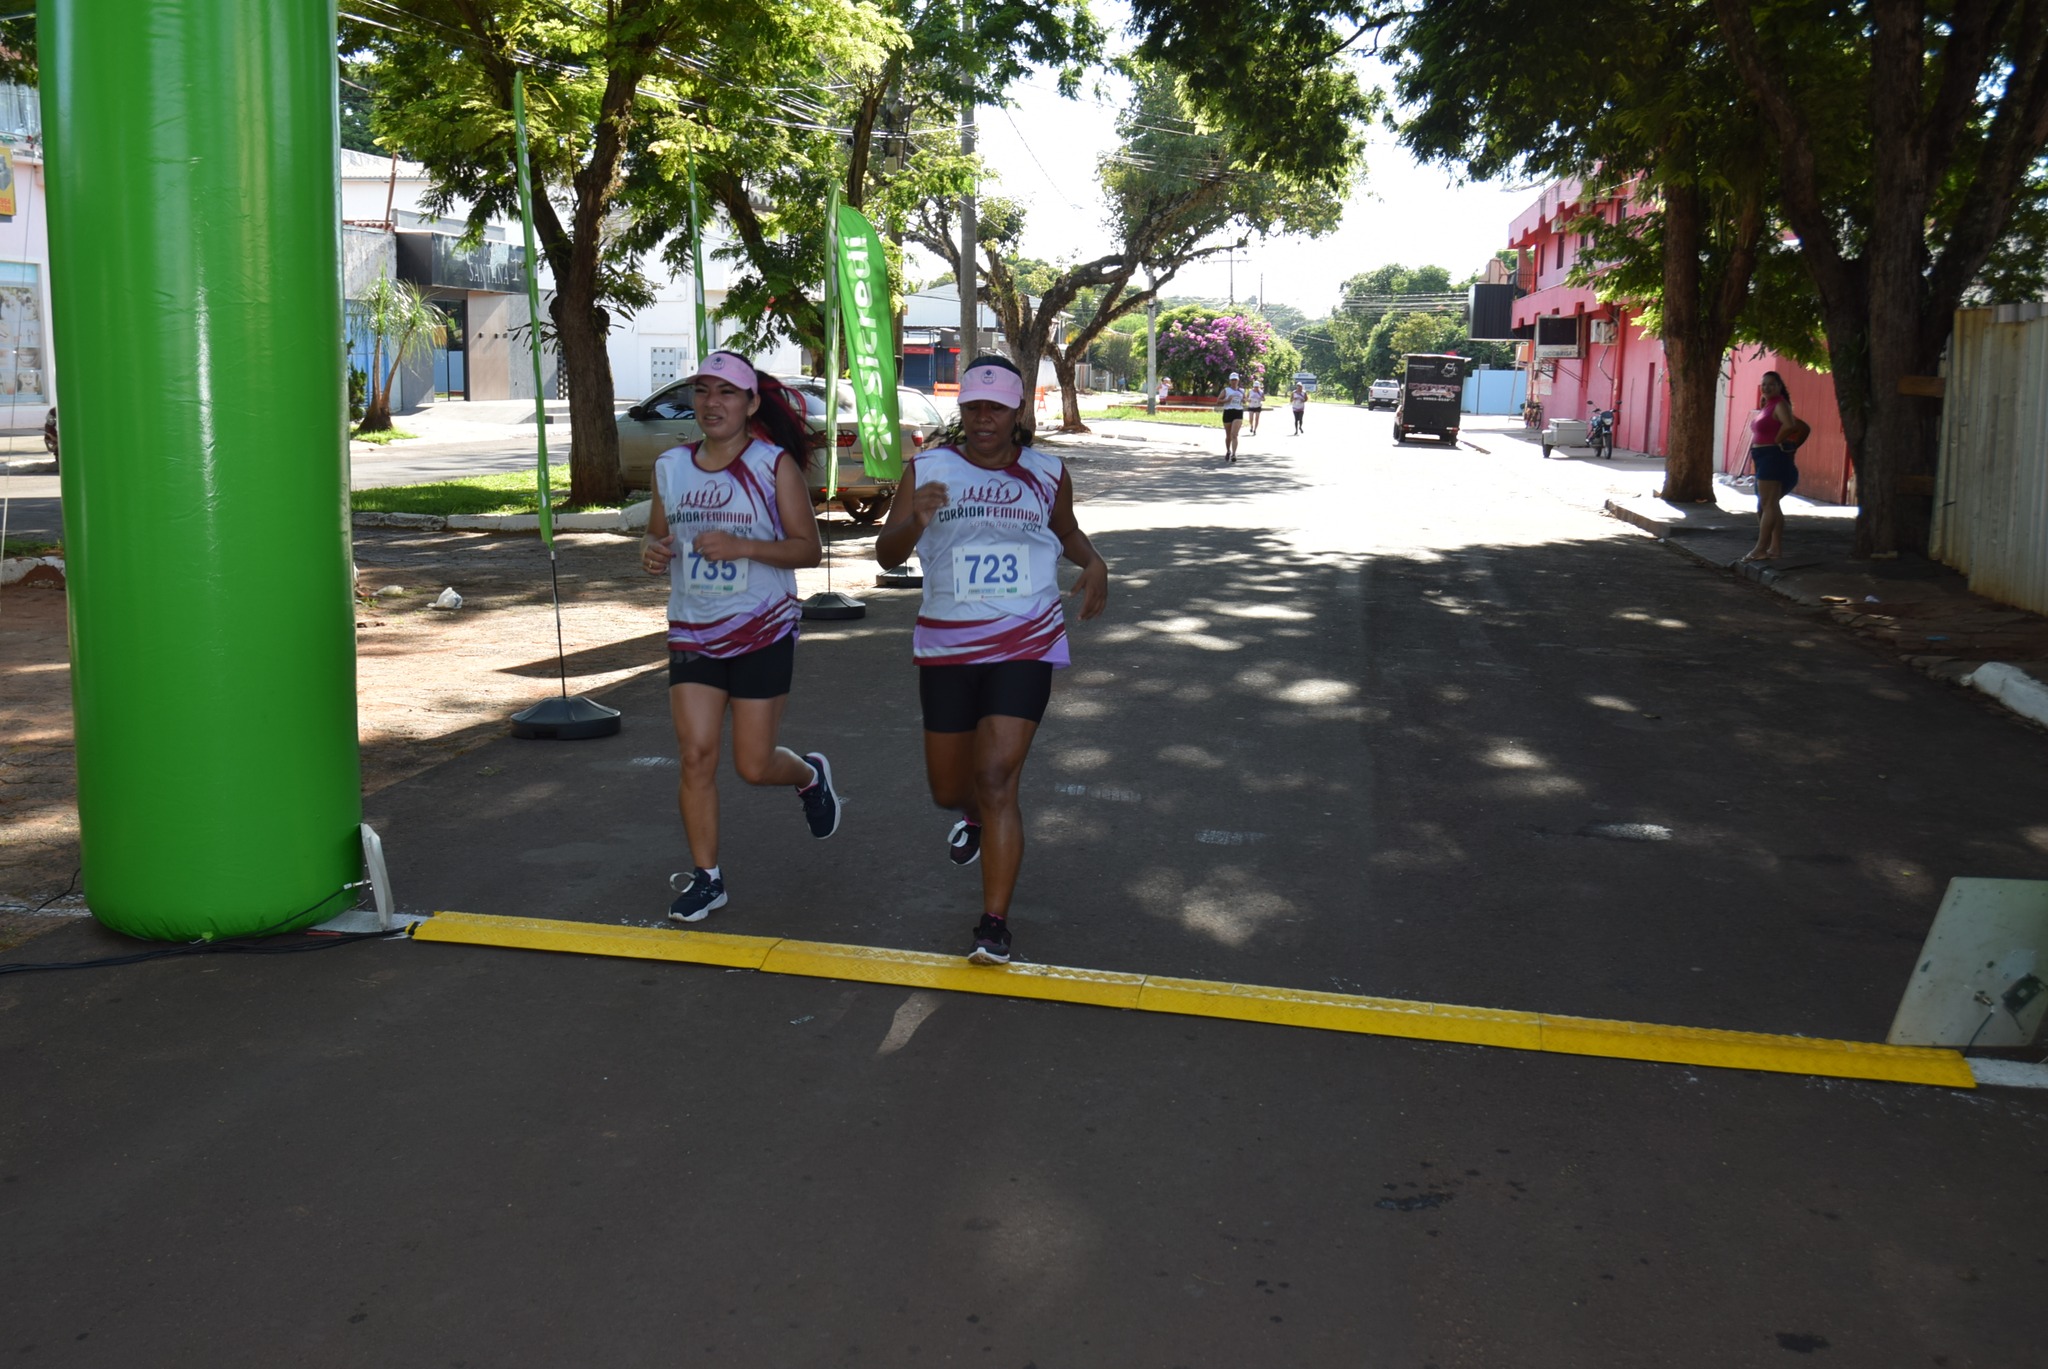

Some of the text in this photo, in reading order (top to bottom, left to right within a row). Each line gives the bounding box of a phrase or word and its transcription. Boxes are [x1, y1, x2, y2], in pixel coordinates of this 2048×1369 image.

[468, 262, 510, 285] SANTANA
[843, 232, 884, 399] sicredi
[700, 511, 752, 525] FEMININA
[938, 506, 985, 523] CORRIDA
[688, 552, 738, 581] 735
[964, 553, 1019, 584] 723
